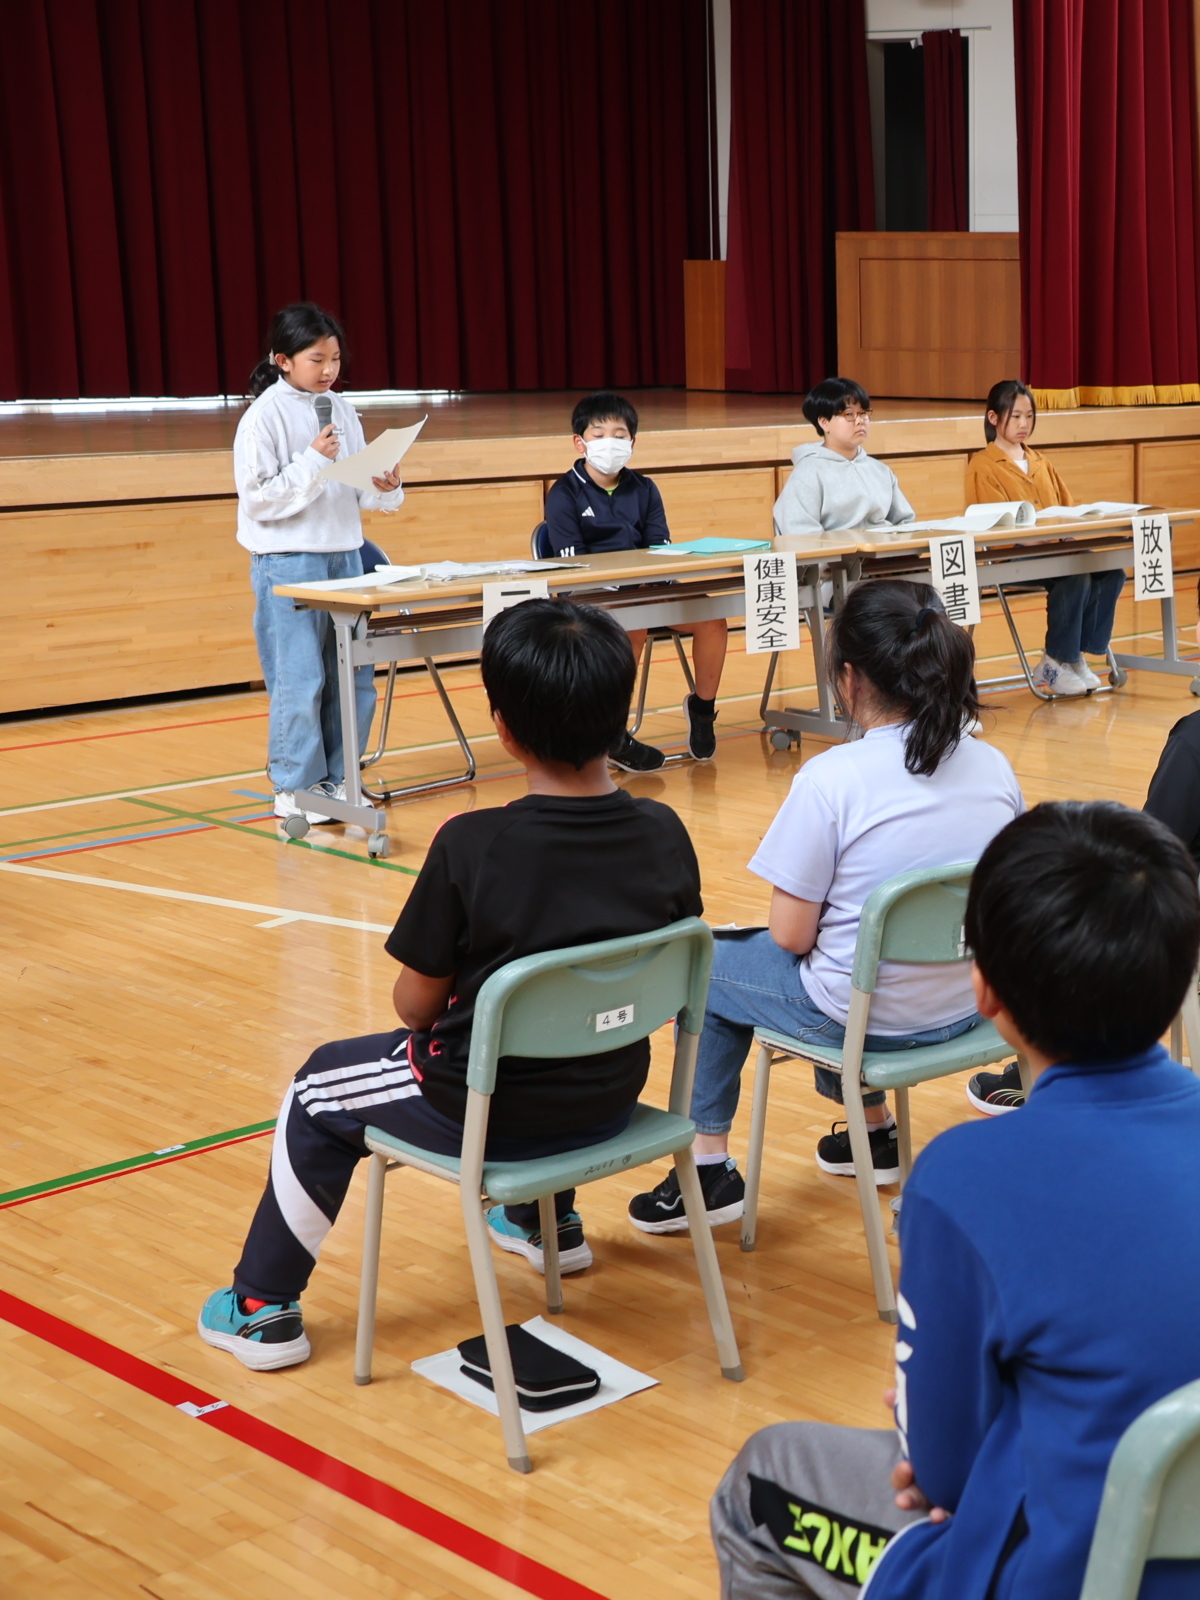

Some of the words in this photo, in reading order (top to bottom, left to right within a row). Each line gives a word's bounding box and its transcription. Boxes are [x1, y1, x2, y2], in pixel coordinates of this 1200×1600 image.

[939, 539, 970, 622] 図書
[1140, 518, 1166, 595] 放送
[753, 556, 788, 650] 健康安全
